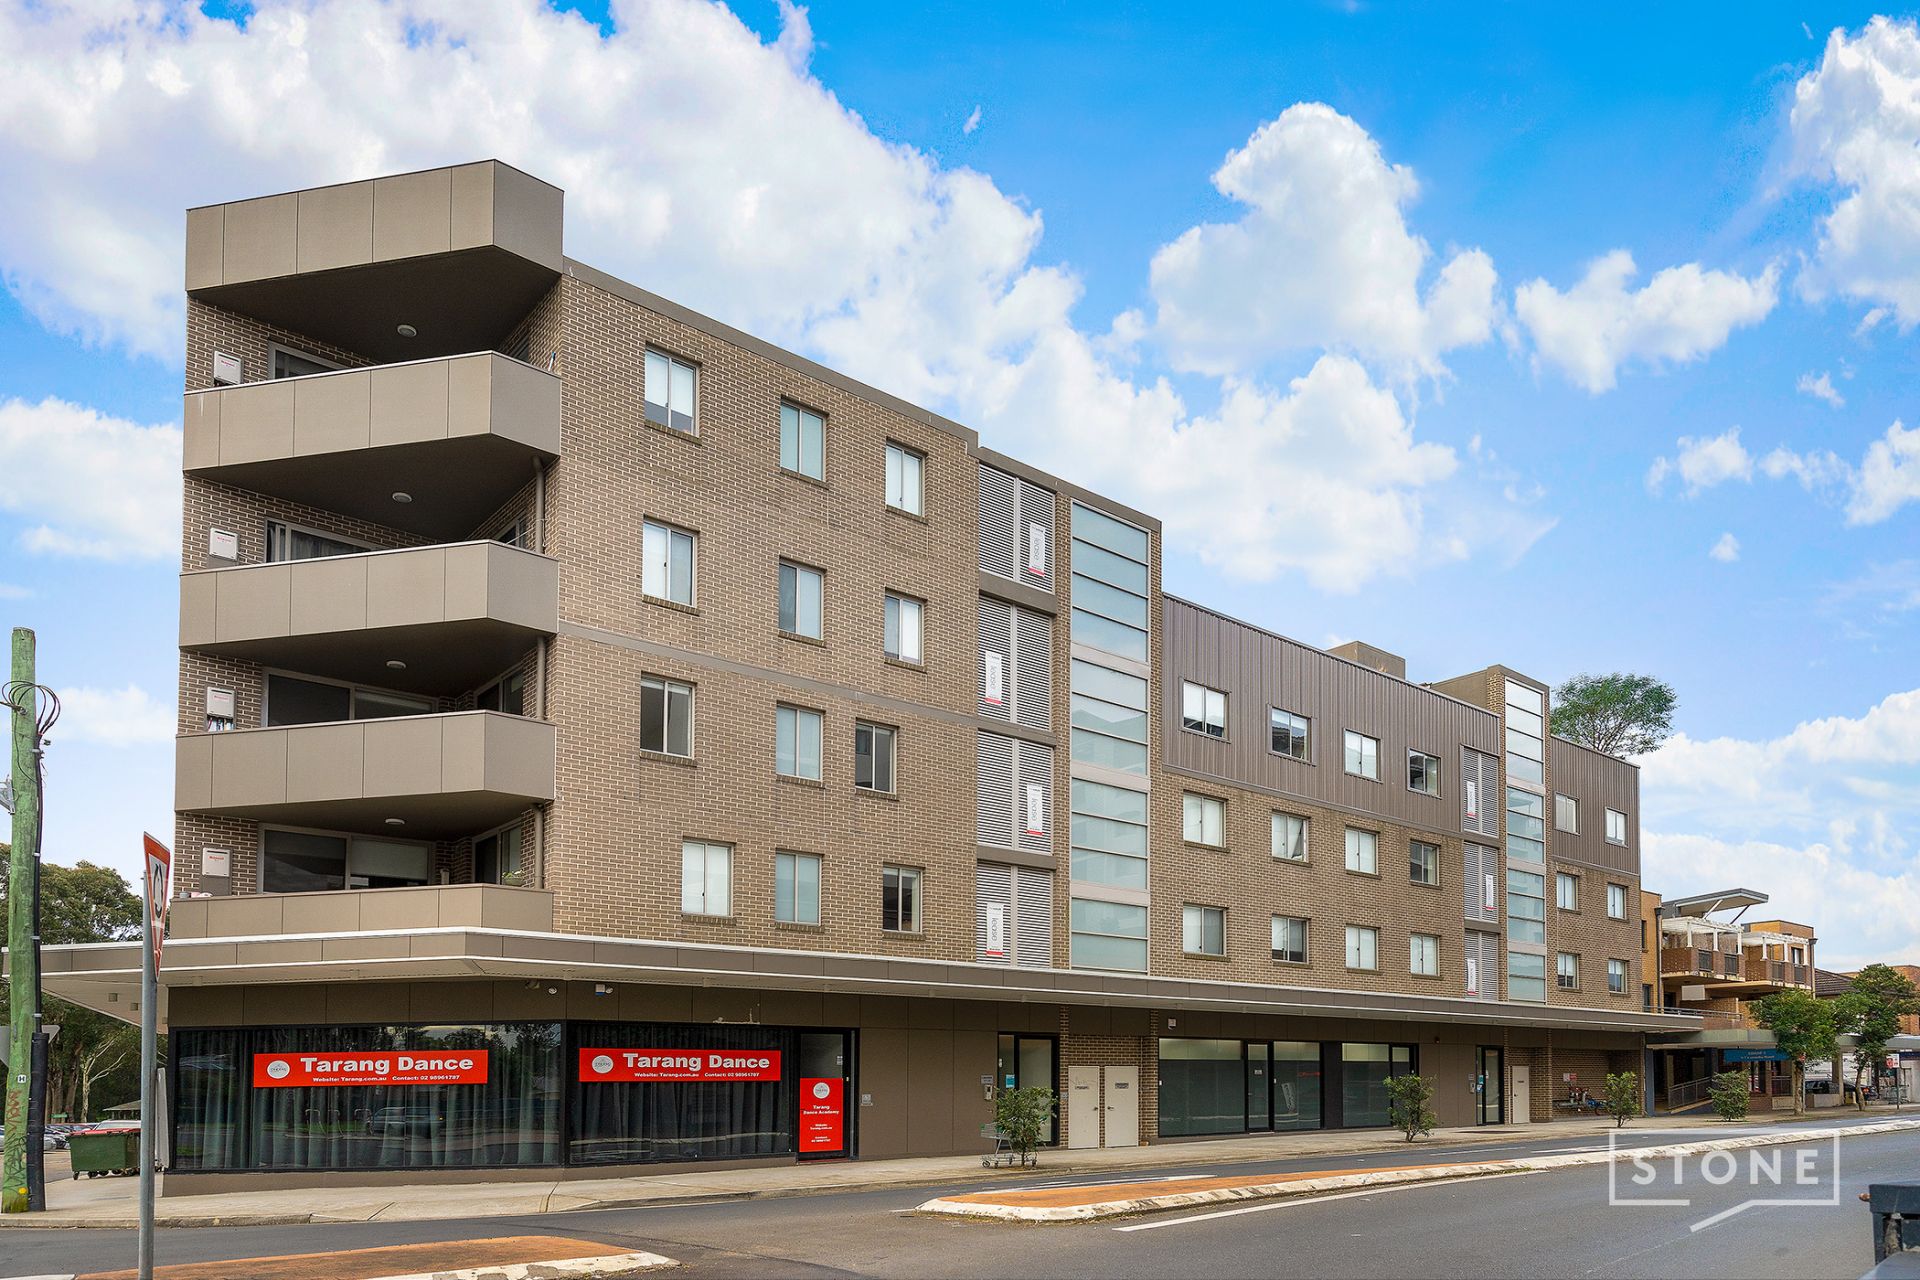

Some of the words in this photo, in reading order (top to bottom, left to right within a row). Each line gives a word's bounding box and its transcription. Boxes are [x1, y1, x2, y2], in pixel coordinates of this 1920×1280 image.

[300, 1056, 390, 1075] Tarang
[398, 1056, 474, 1071] Dance
[623, 1053, 702, 1072] Tarang
[709, 1055, 770, 1069] Dance
